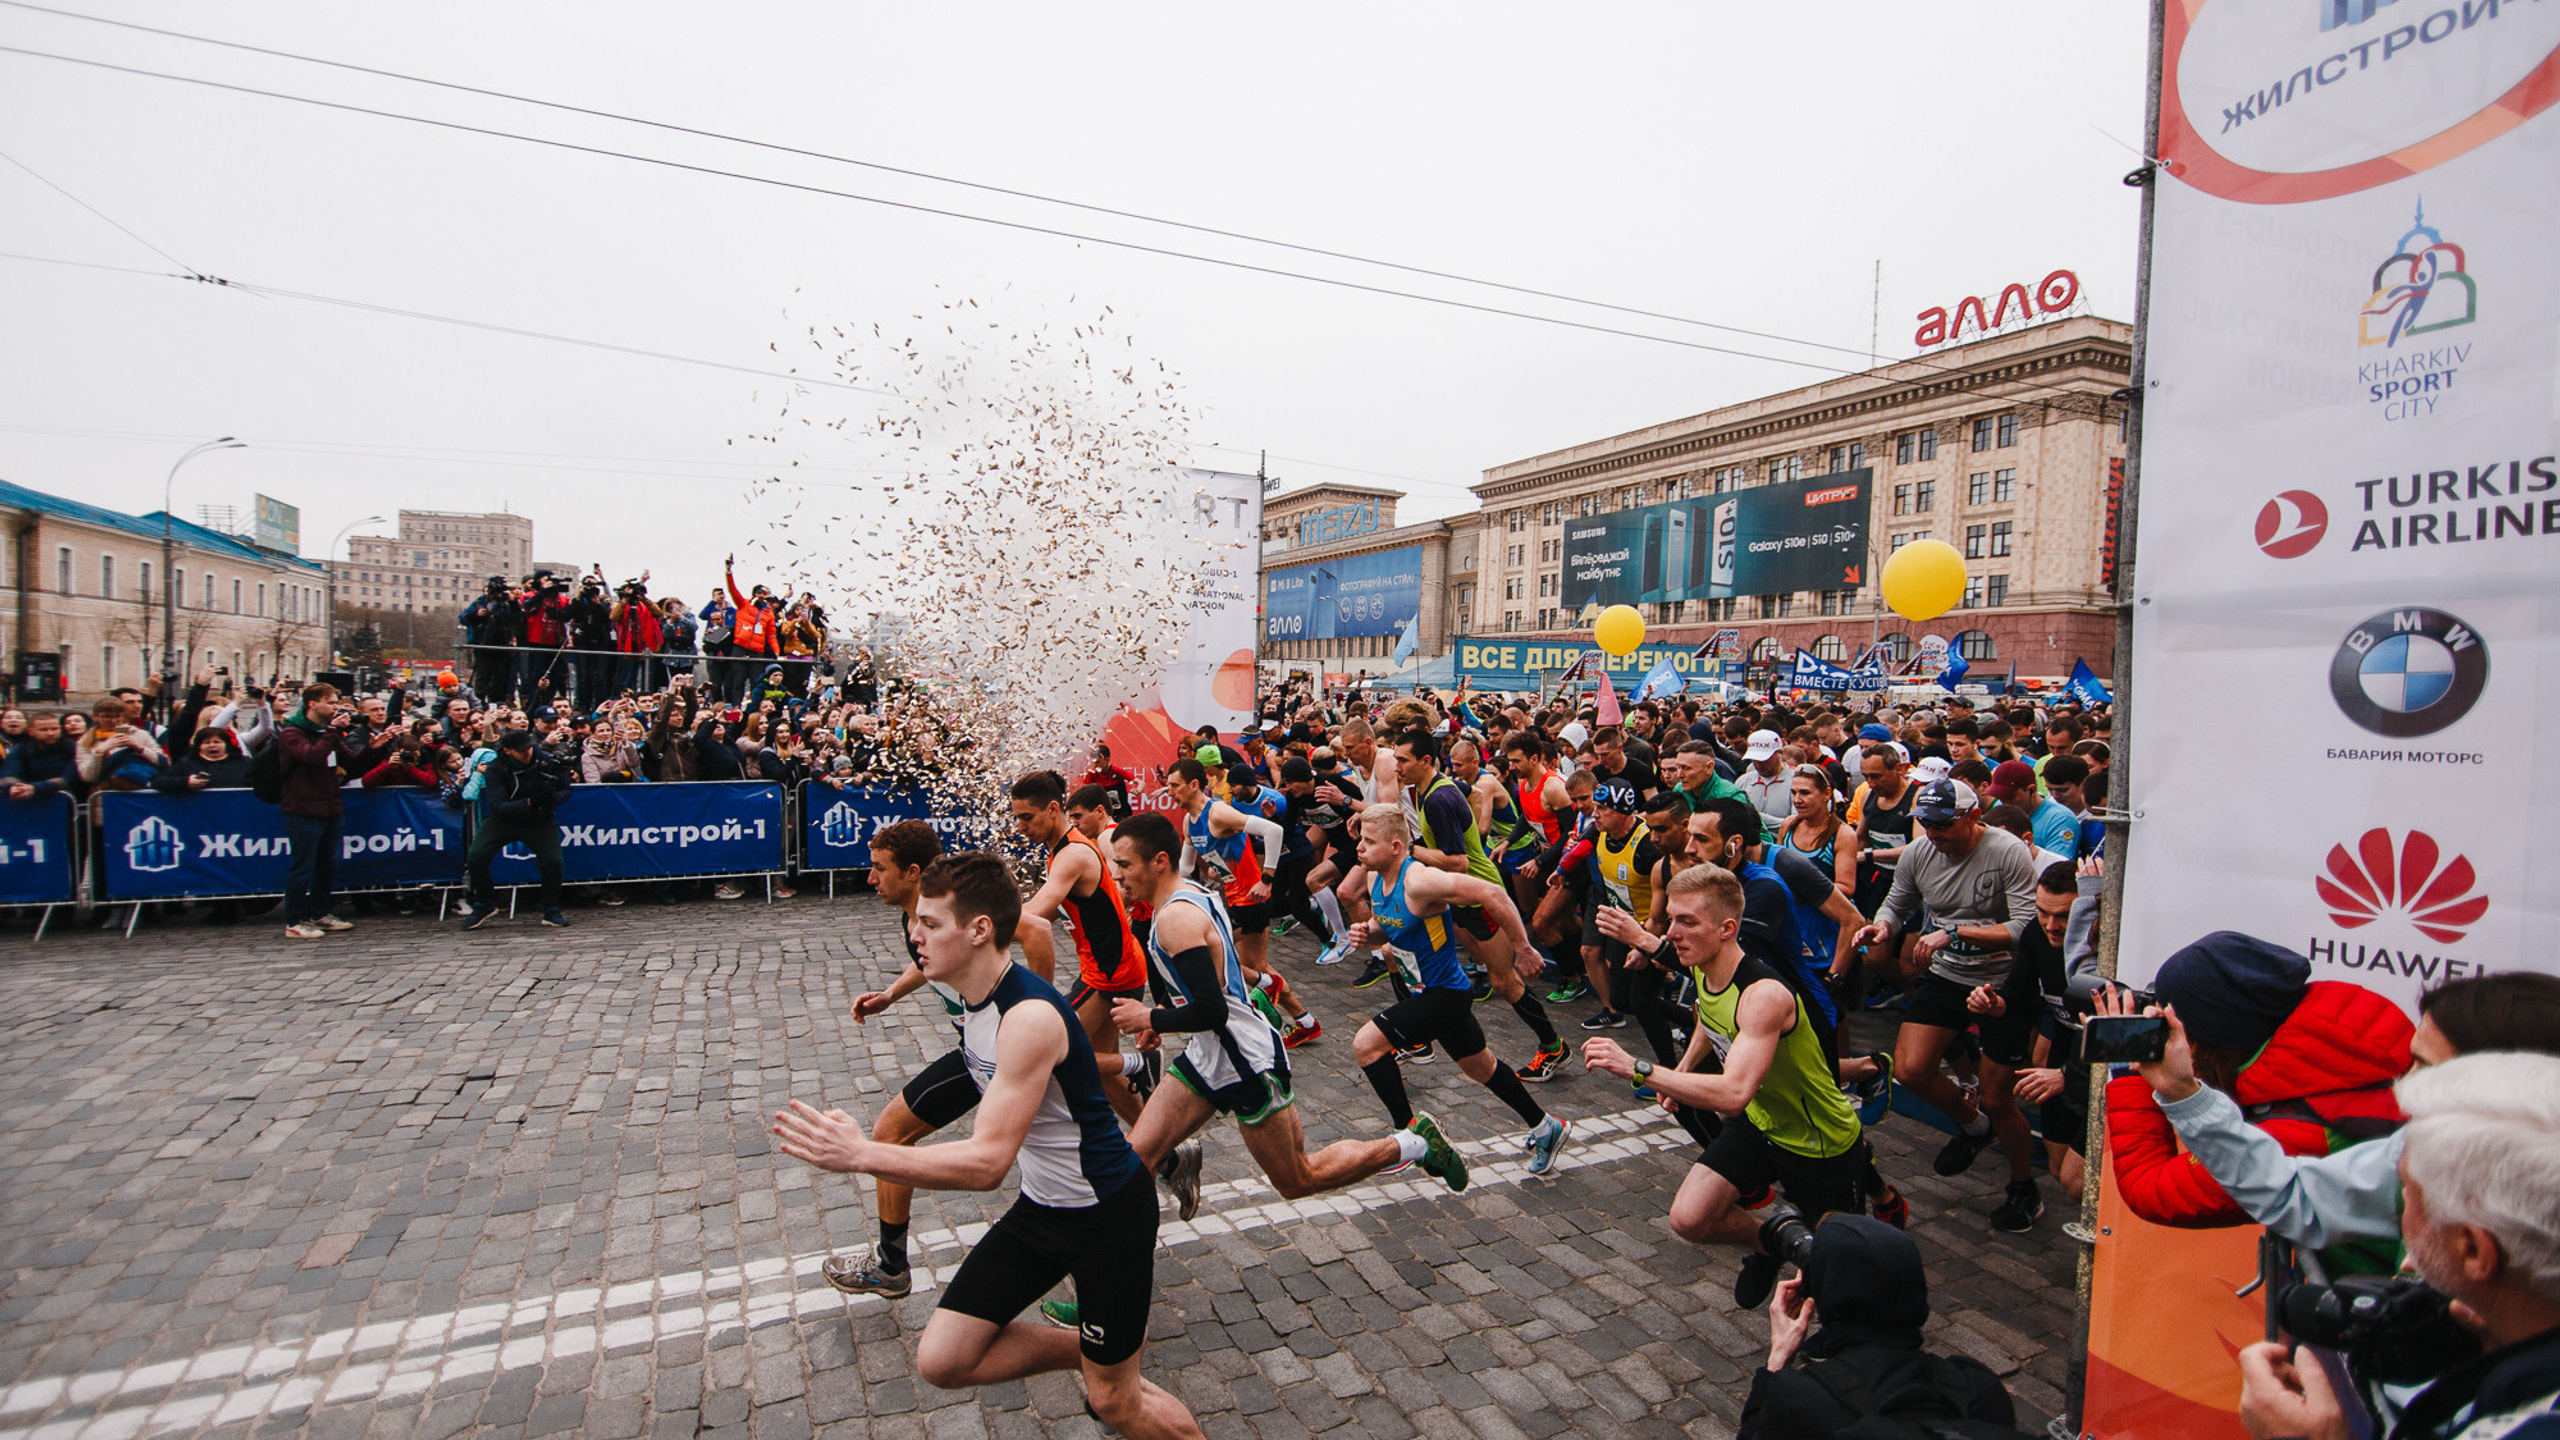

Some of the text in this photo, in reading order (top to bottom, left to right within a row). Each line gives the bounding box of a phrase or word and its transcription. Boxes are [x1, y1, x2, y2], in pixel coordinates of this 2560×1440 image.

[2358, 341, 2473, 385] KHARKIV
[2369, 367, 2459, 403] SPORT
[2384, 394, 2440, 422] CITY
[1806, 487, 1857, 504] ЦИТРУС
[2354, 456, 2558, 512] TURKIS
[1300, 498, 1380, 546] MEIZU
[1571, 527, 1607, 540] SAMSUNG
[2350, 498, 2560, 552] AIRLINE
[1717, 505, 1737, 571] S10+
[1748, 530, 1857, 553] Galaxy S10e S10 S10+
[2346, 610, 2477, 655] BMW
[1462, 645, 1516, 669] ВСЕ
[1524, 648, 1579, 674] ДЛЯ
[1794, 674, 1846, 689] ВМЕСТЕ
[1849, 676, 1858, 689] К
[2326, 748, 2484, 765] БАВАРИЯ МОТОРС
[199, 827, 444, 859] Жилрой-1
[560, 818, 766, 848] Жилстрой-1
